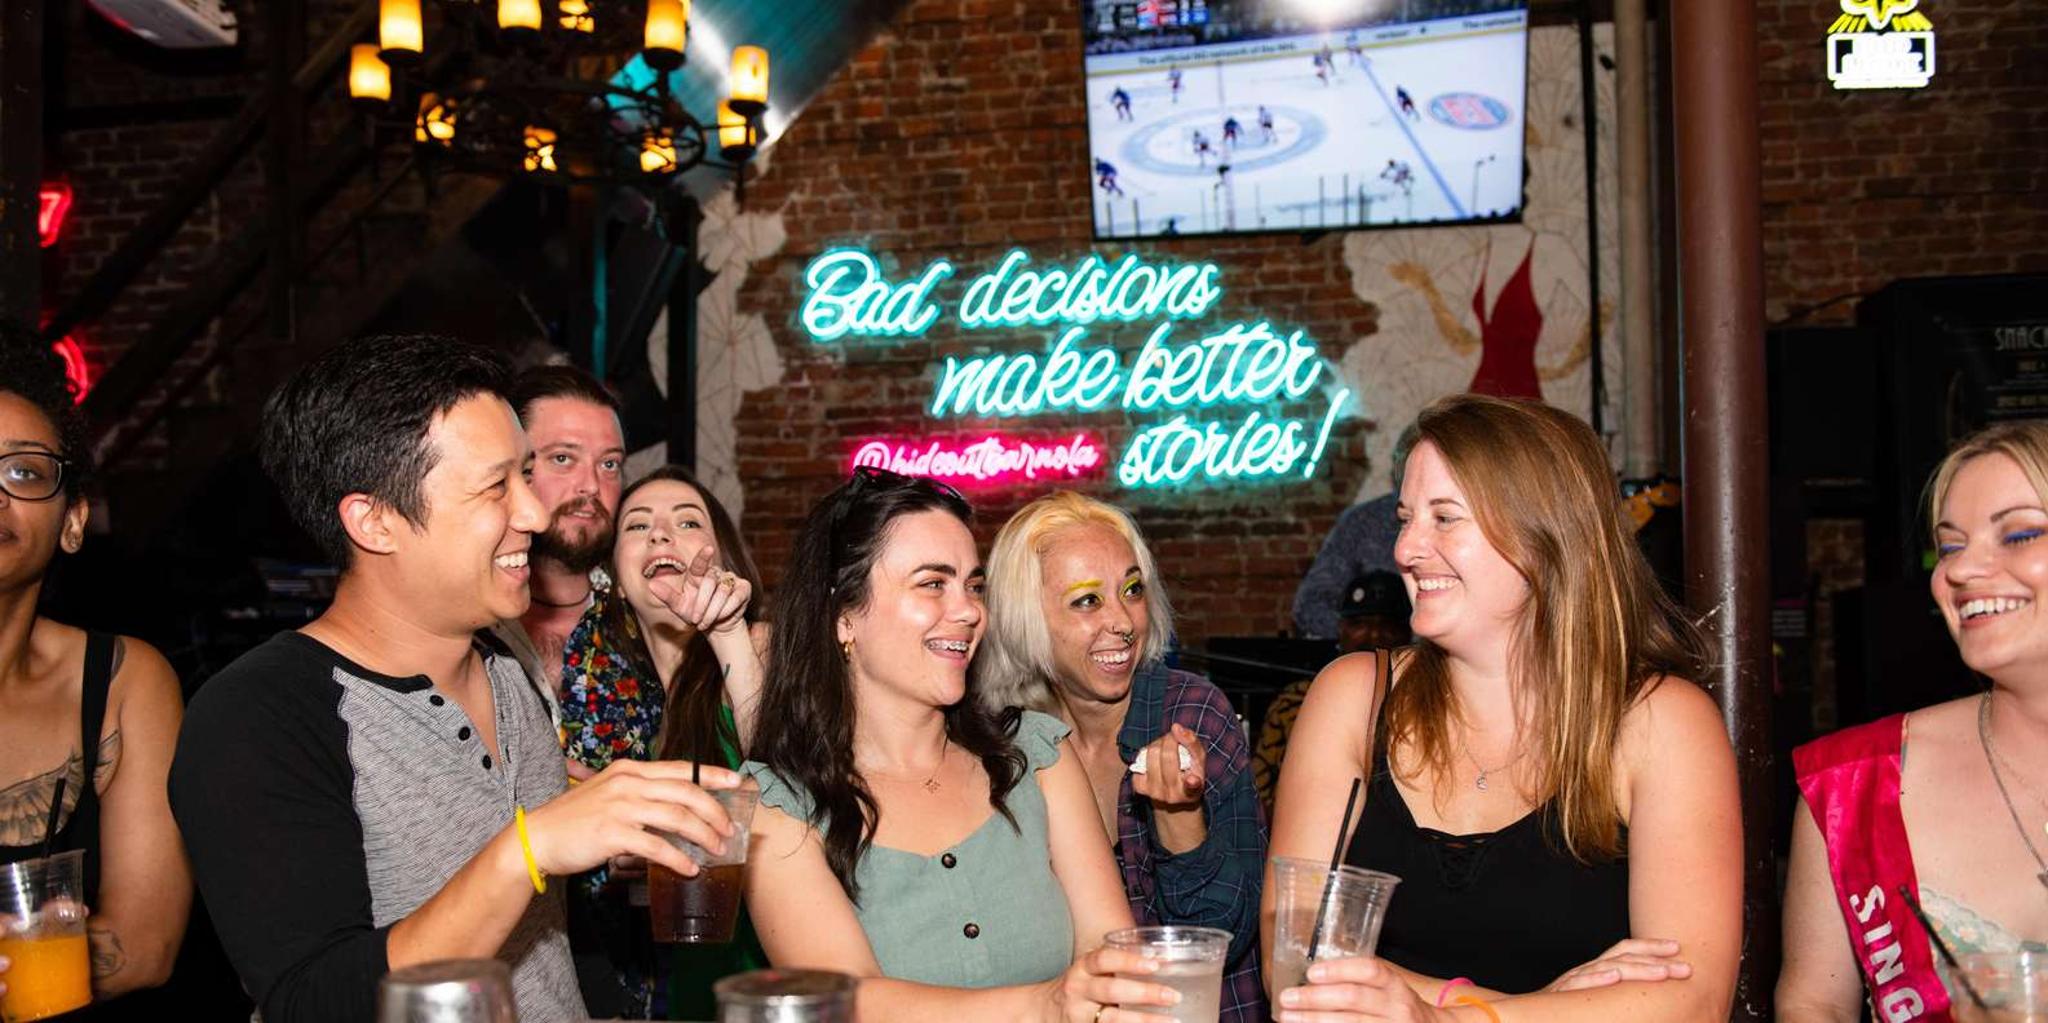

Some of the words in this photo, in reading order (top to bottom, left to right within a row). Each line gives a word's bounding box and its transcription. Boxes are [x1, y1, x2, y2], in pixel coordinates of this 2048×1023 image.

[803, 250, 951, 337] Bad
[959, 250, 1221, 324] decisions
[932, 325, 1121, 417] make
[1122, 321, 1322, 410] better
[1120, 388, 1350, 487] stories!
